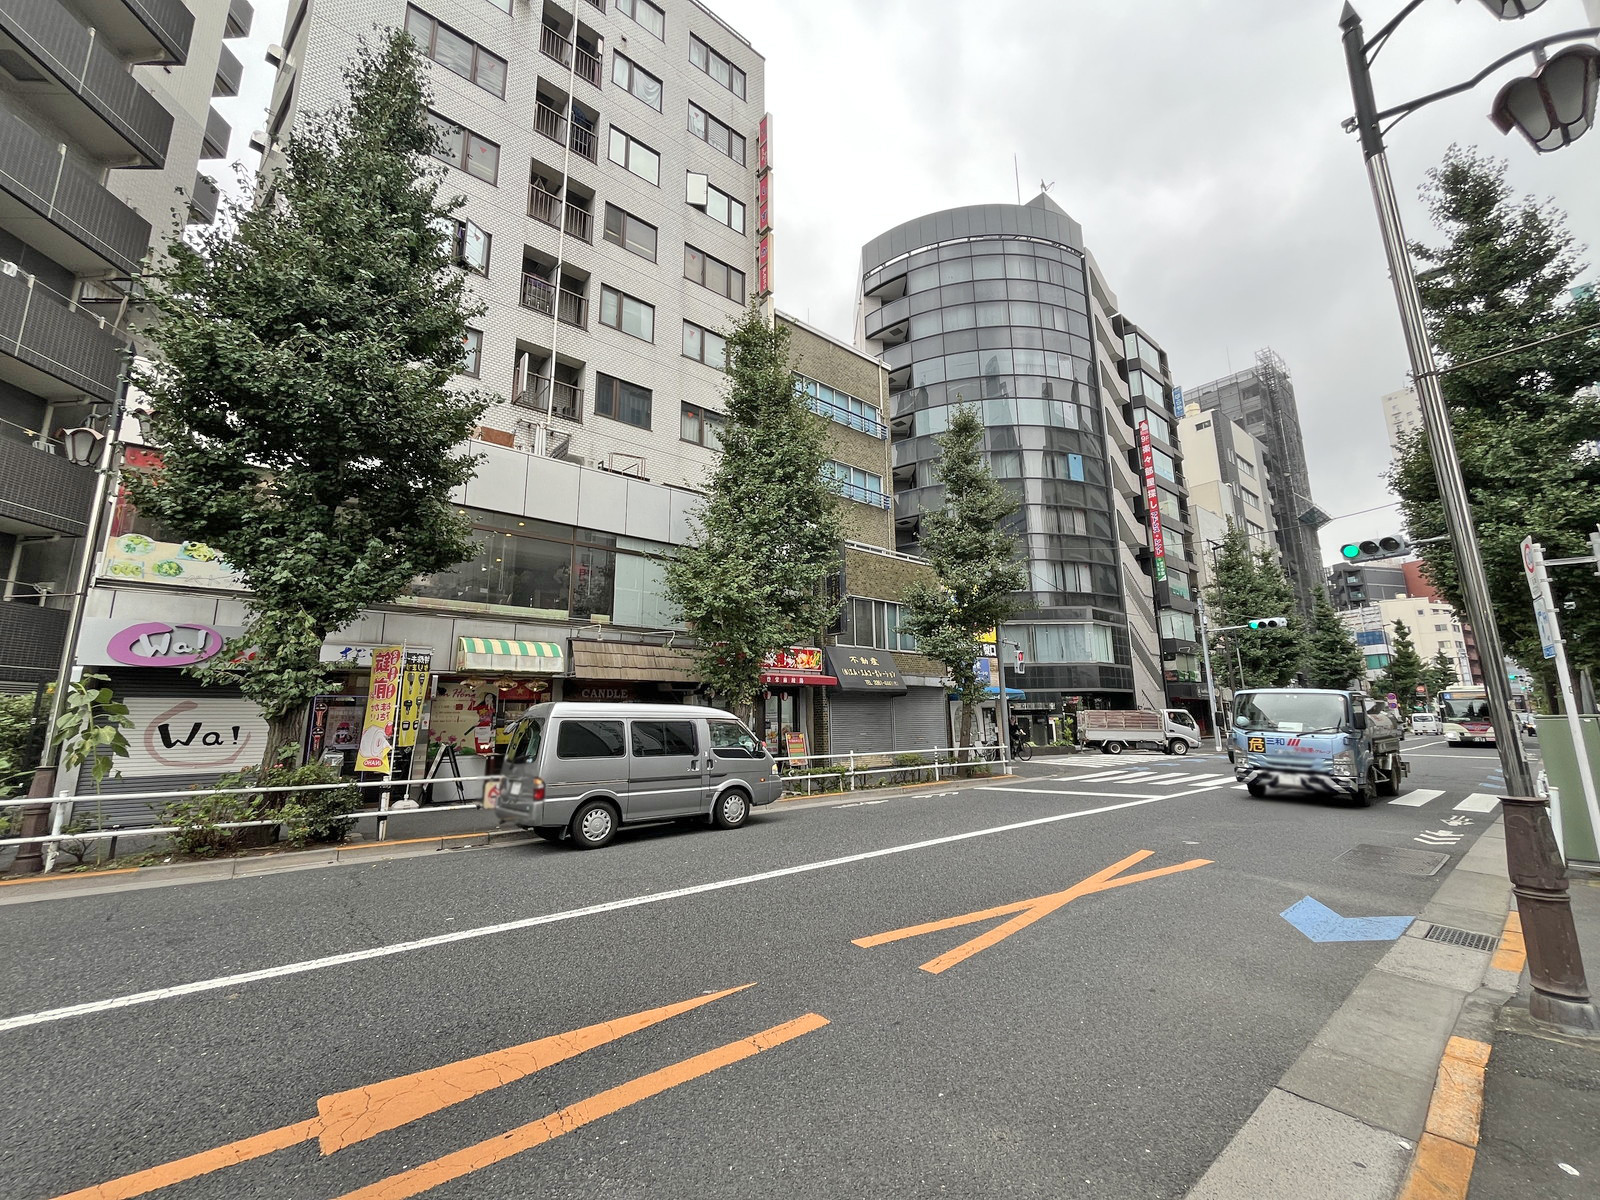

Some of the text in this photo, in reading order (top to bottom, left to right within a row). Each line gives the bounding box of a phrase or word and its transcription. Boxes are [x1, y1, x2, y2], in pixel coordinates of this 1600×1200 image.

[139, 629, 208, 657] Wa!
[849, 656, 880, 666] 不動産
[581, 689, 628, 699] CANDLE
[158, 722, 240, 748] Wa!
[1248, 738, 1265, 752] 危
[1266, 738, 1285, 746] 三和
